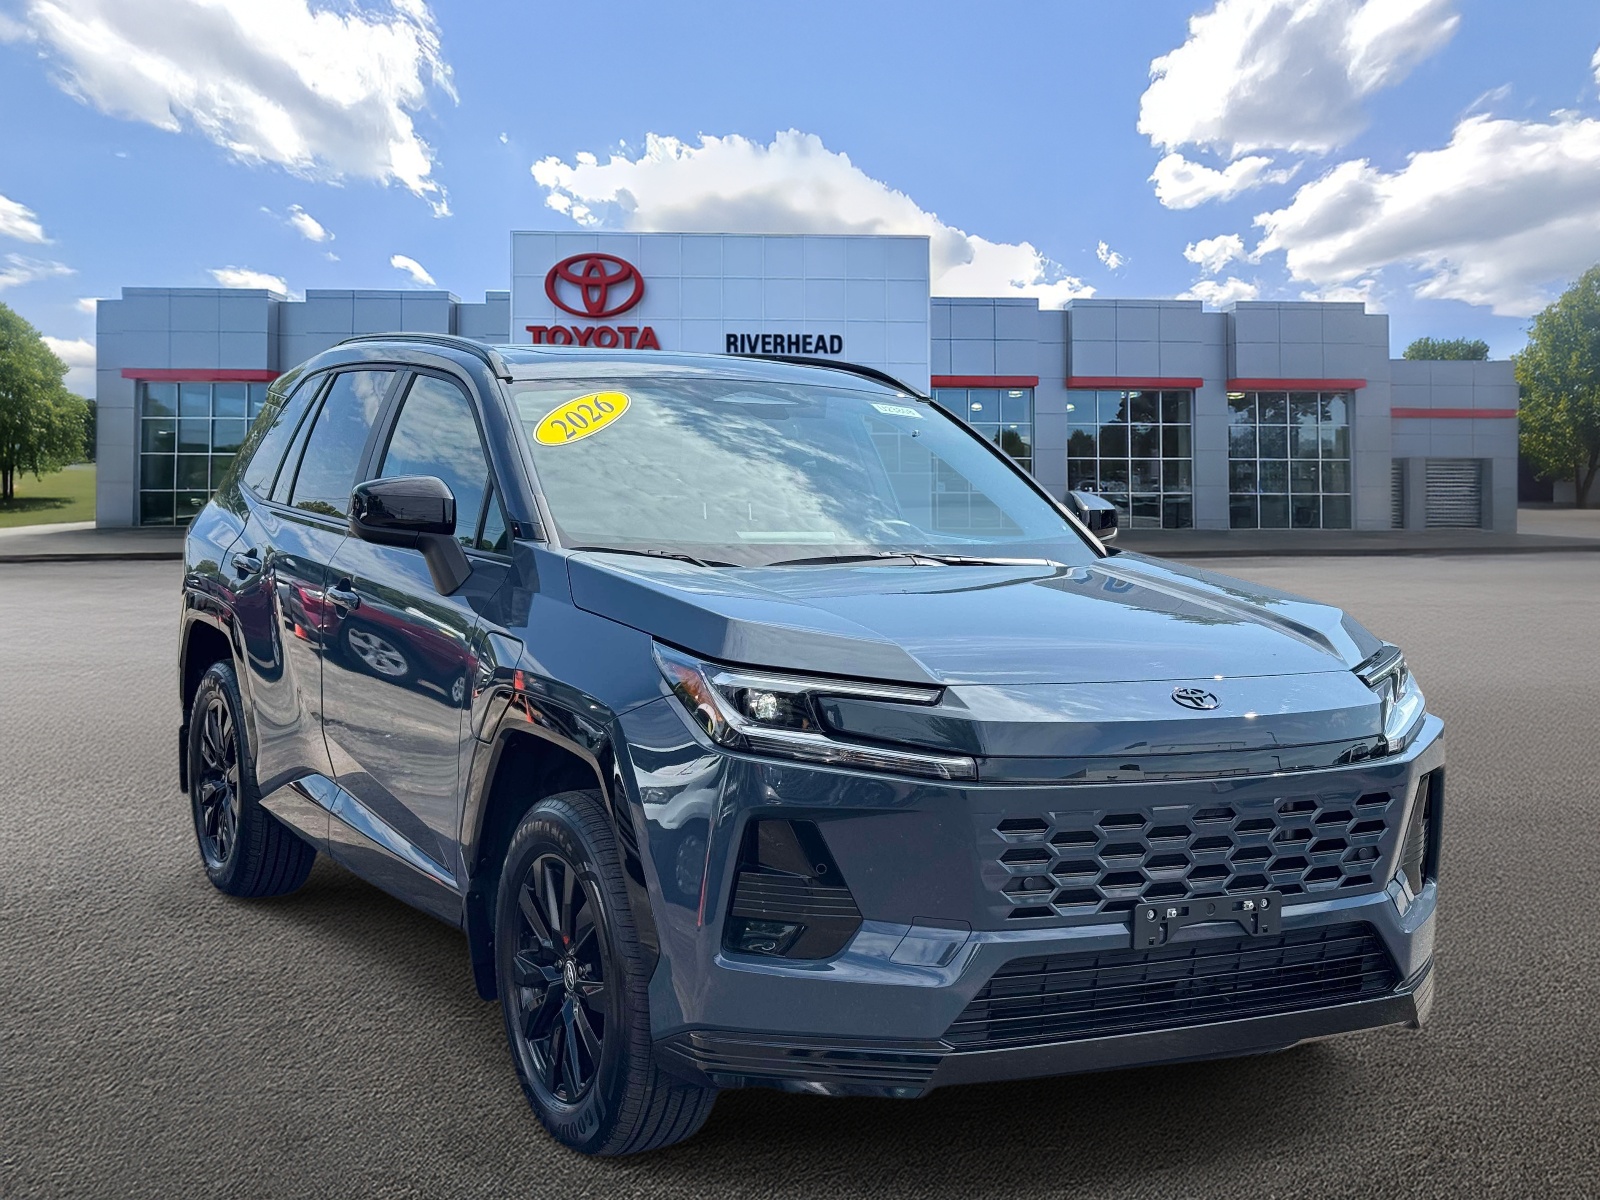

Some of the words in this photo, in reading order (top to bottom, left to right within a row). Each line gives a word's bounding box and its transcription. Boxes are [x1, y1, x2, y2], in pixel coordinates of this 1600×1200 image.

[525, 325, 661, 351] TOYOTA
[725, 333, 843, 354] RIVERHEAD
[550, 395, 615, 439] 2026
